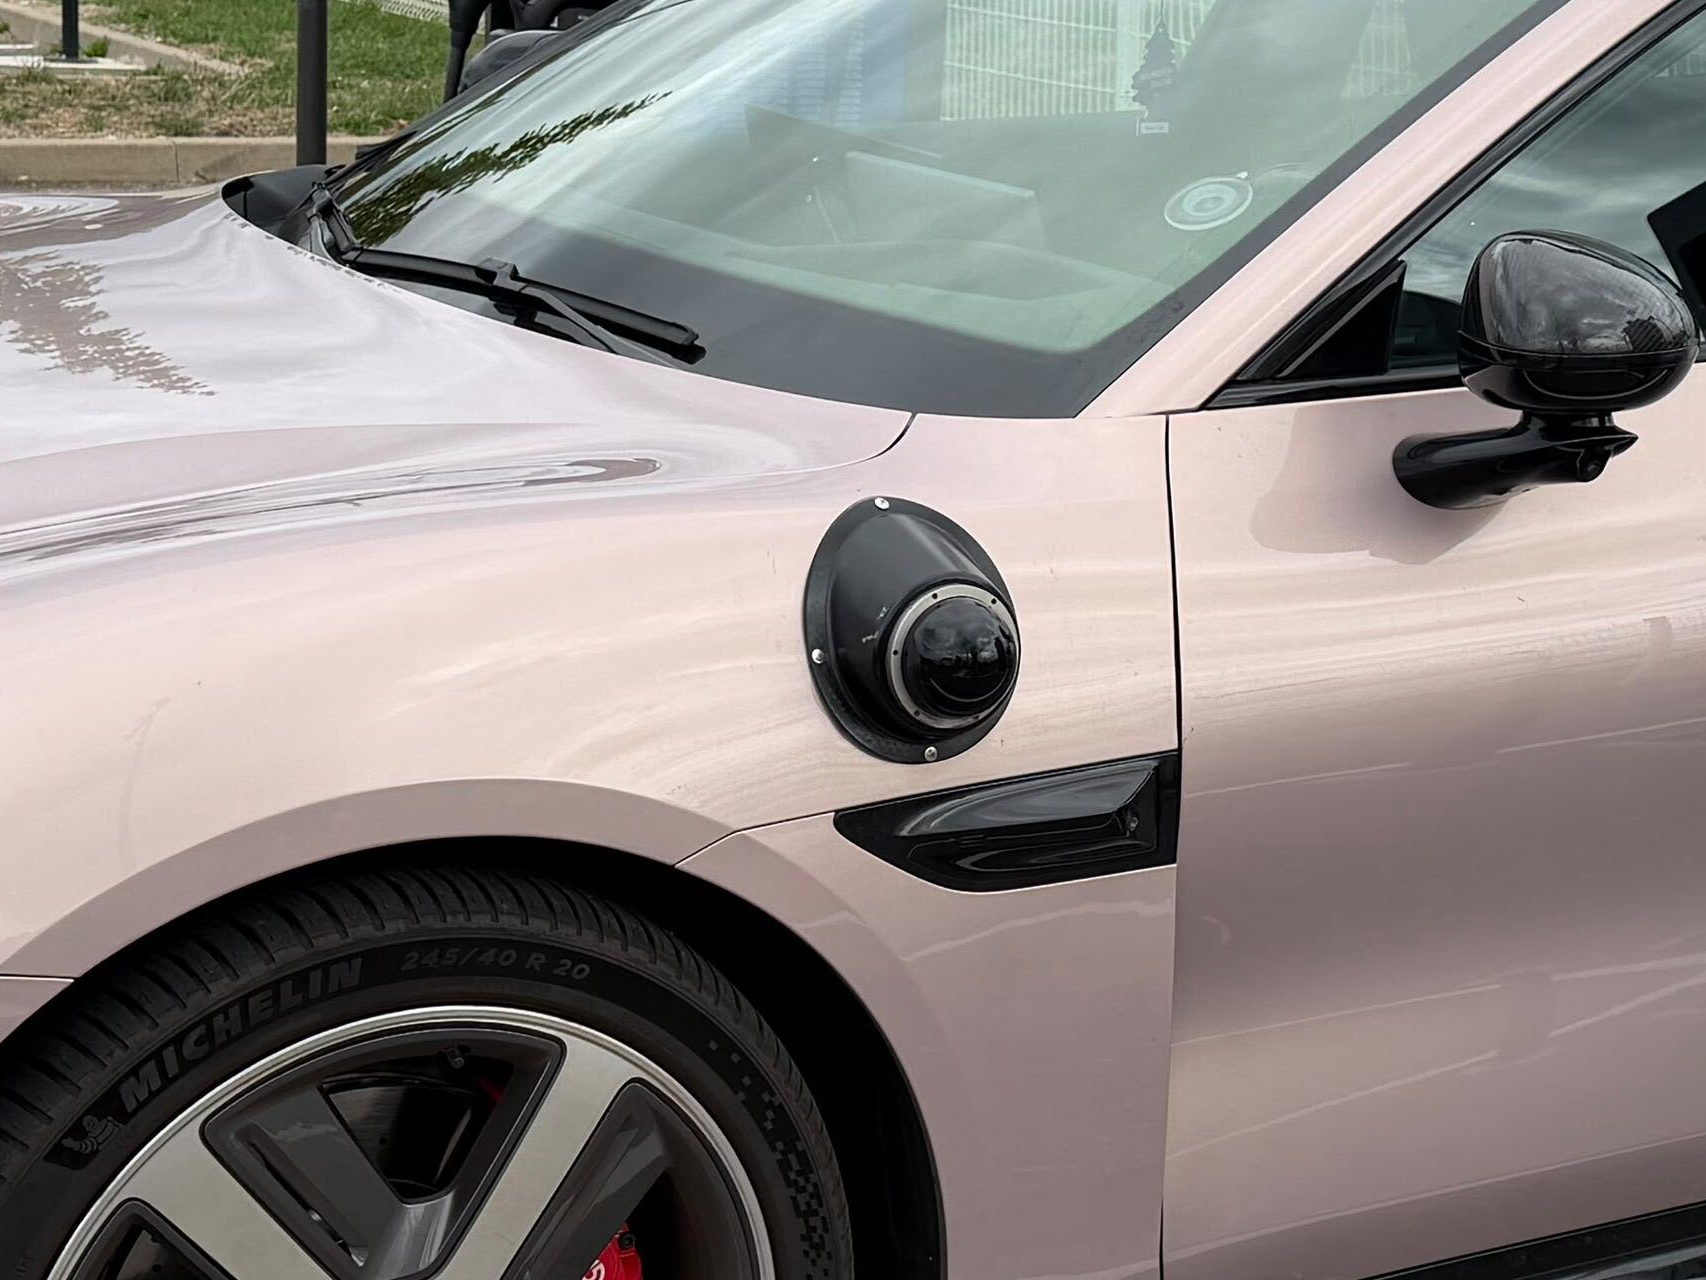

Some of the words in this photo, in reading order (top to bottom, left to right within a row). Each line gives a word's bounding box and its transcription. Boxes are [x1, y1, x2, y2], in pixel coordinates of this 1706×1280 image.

[399, 946, 519, 974] 245/40
[524, 951, 545, 973] R
[553, 957, 592, 981] 20
[119, 956, 364, 1115] MICHELIN
